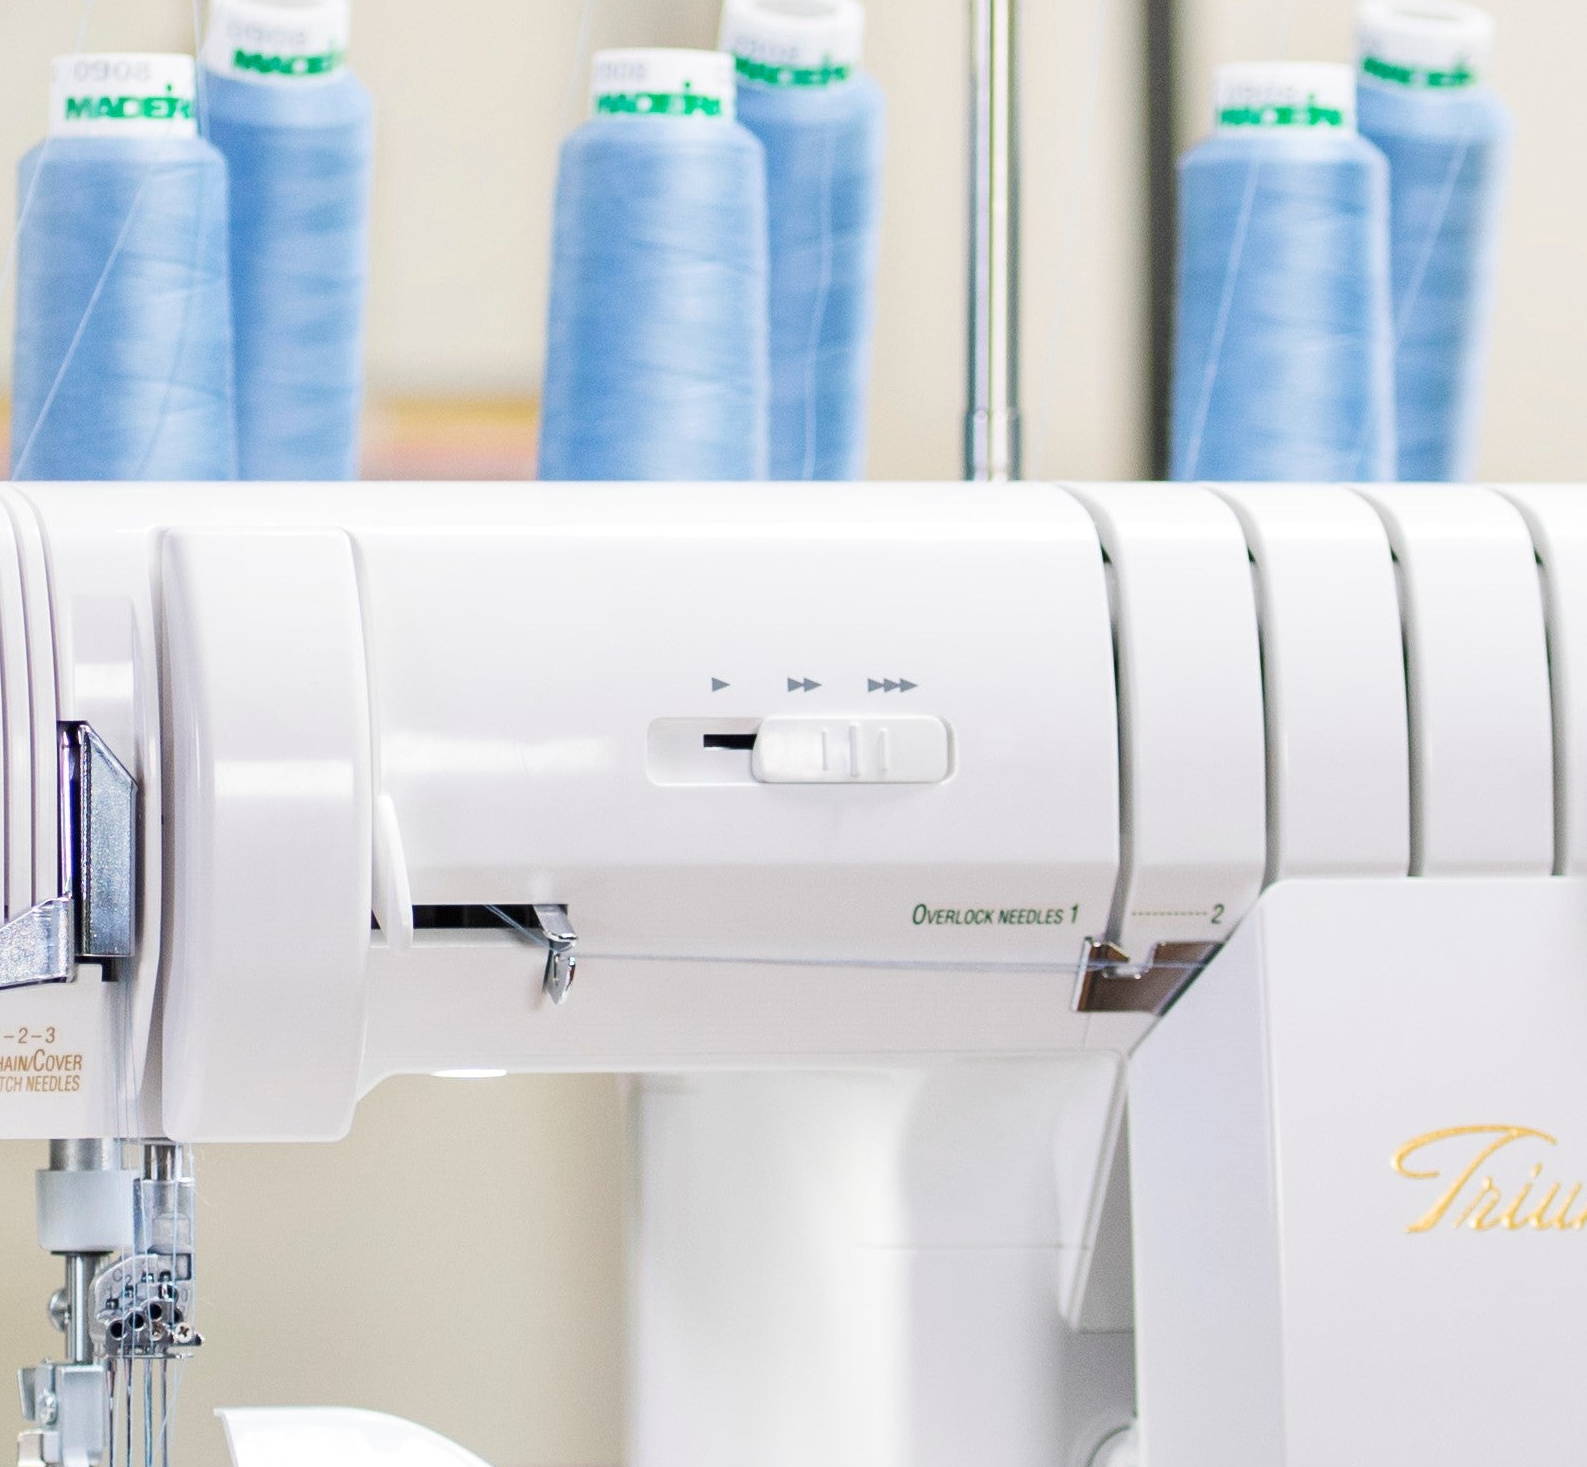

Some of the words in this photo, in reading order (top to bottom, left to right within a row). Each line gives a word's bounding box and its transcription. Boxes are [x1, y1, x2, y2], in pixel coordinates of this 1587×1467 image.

[911, 903, 994, 926] OVERLOCK
[997, 907, 1065, 926] NEEDLES
[1069, 903, 1081, 925] 1
[1210, 903, 1226, 925] 2
[25, 1074, 82, 1093] NEEDLES
